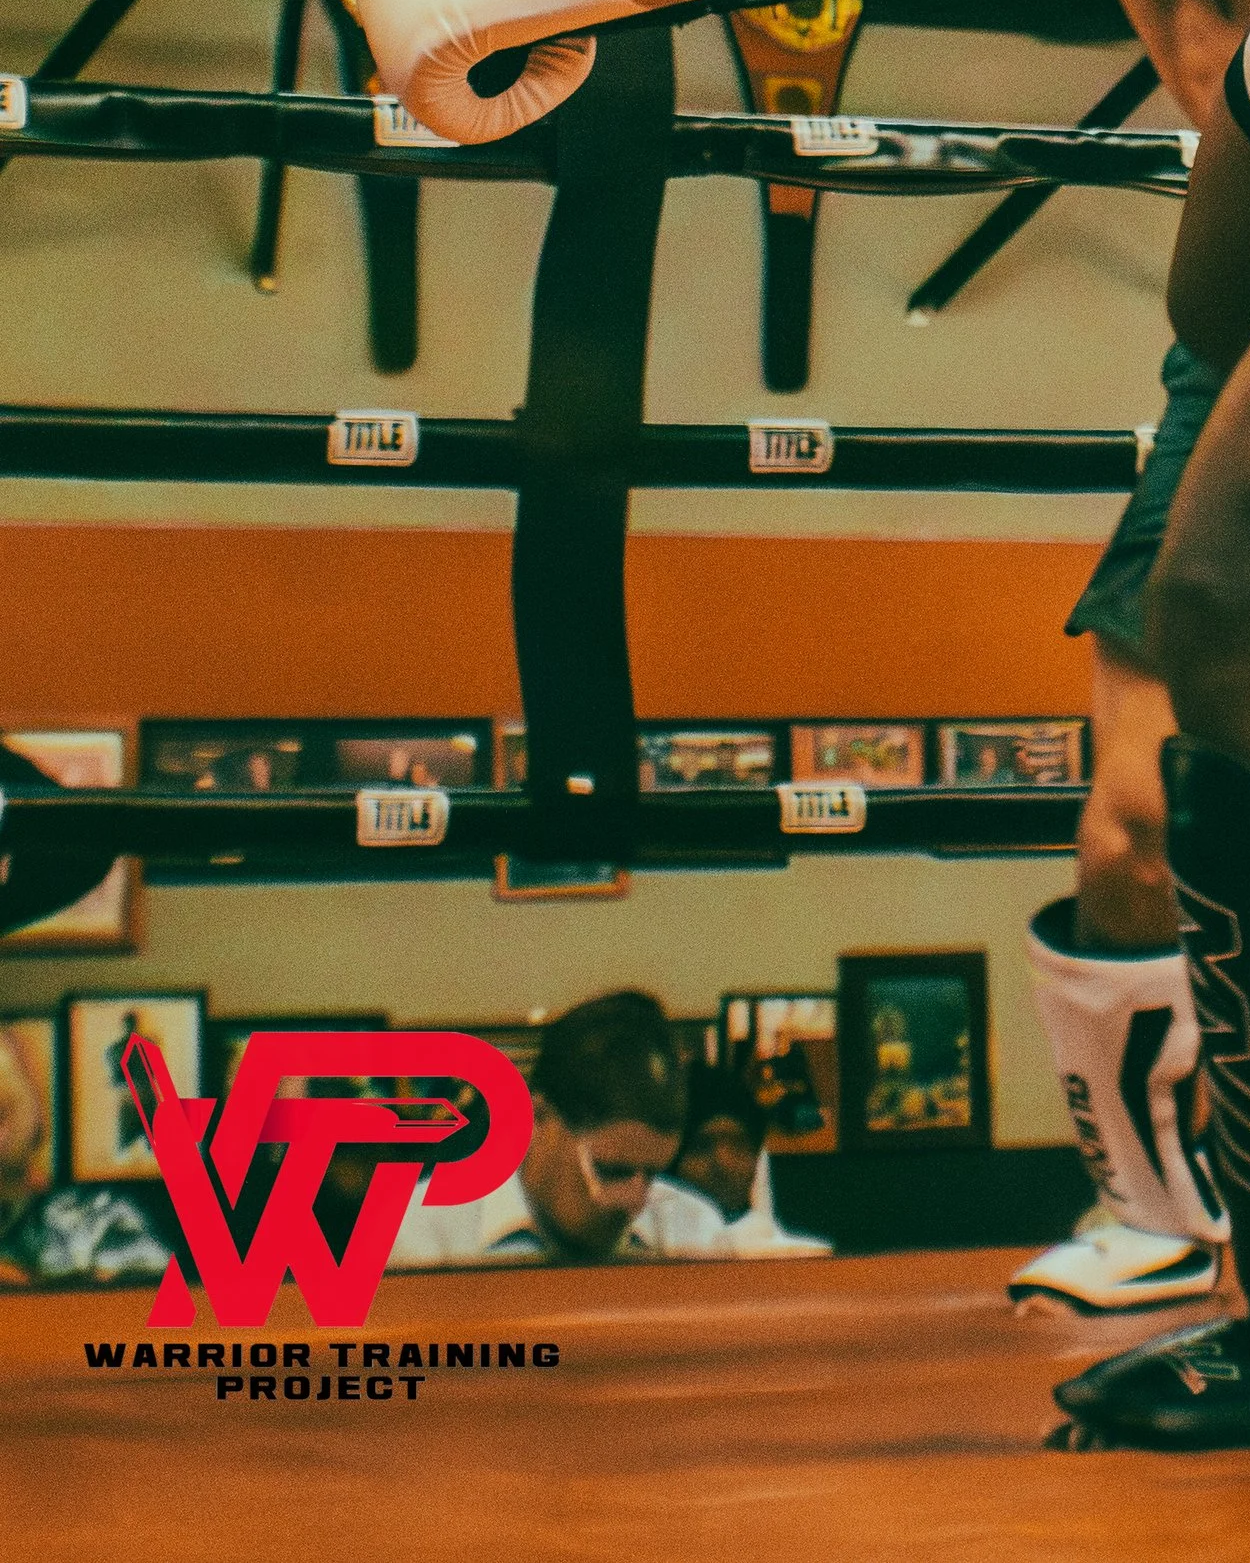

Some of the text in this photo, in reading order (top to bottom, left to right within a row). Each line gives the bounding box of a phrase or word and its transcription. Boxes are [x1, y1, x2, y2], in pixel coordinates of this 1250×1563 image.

[344, 422, 402, 451] TITLE
[373, 799, 430, 830] TITLE
[793, 790, 849, 818] TITLE
